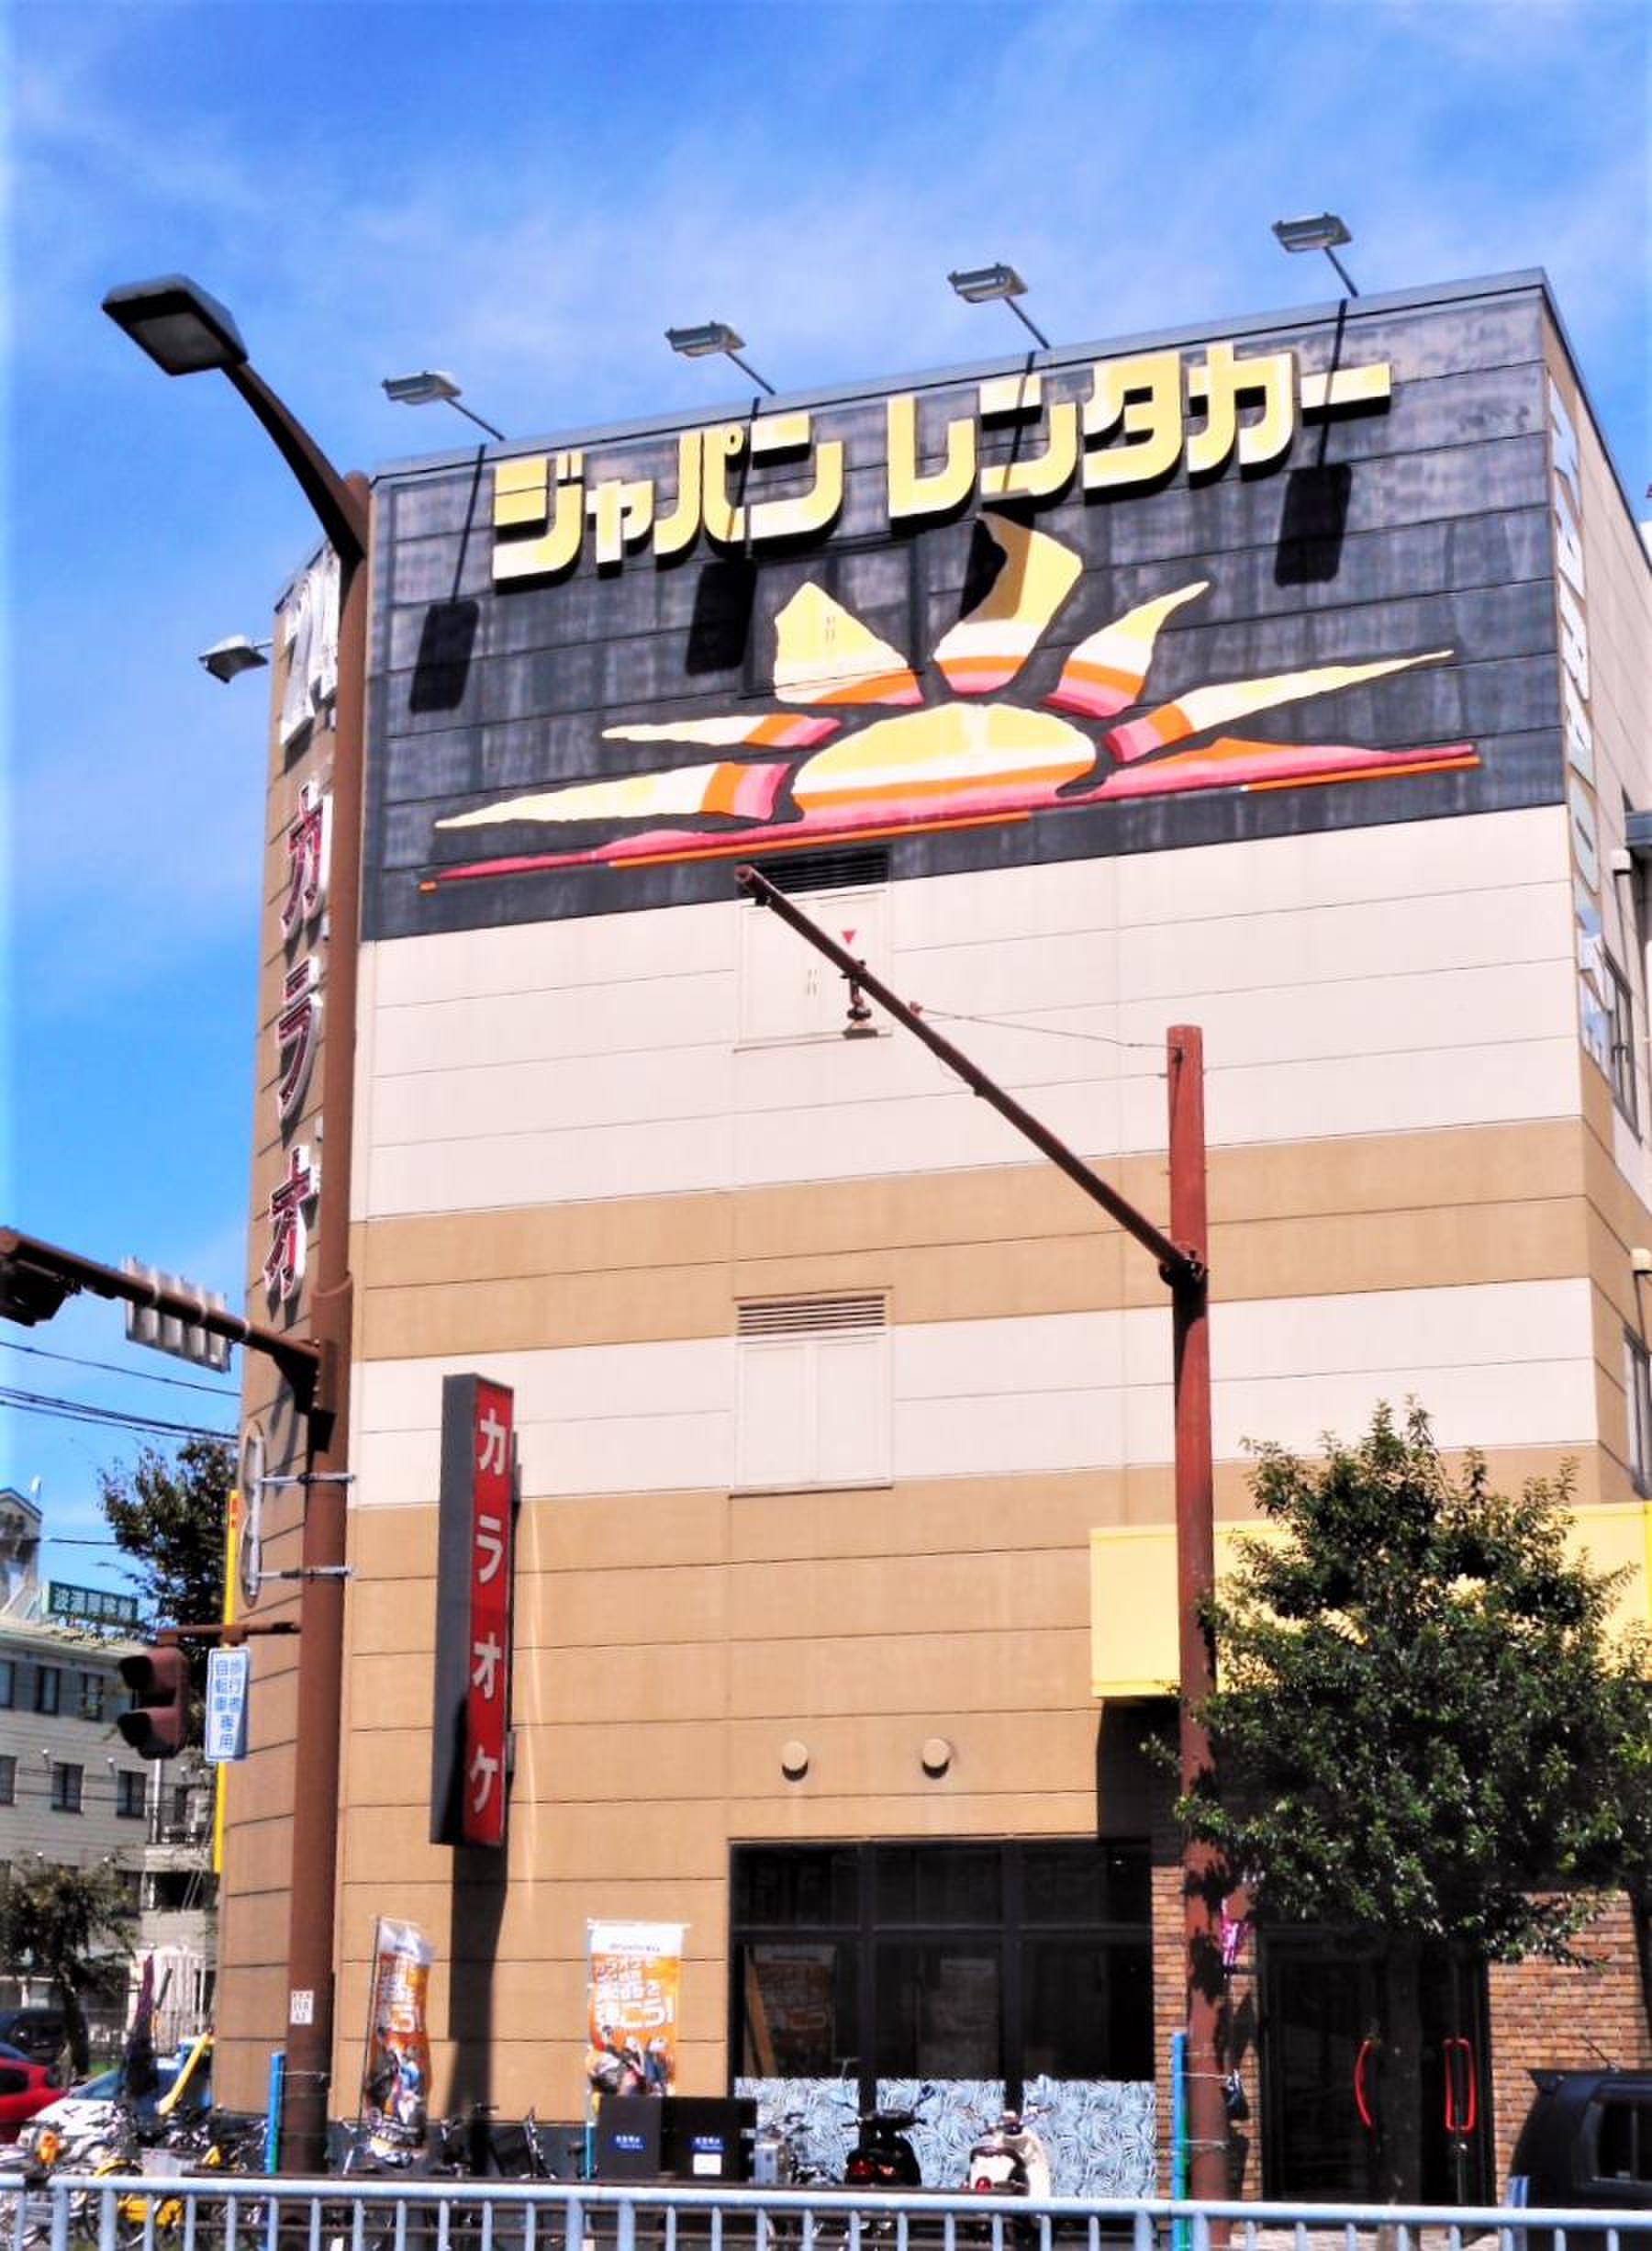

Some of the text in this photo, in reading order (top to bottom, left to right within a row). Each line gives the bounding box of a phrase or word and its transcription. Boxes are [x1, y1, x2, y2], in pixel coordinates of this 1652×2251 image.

[492, 342, 1391, 580] ジャパン レンタカー
[470, 1409, 505, 1814] カラオケ
